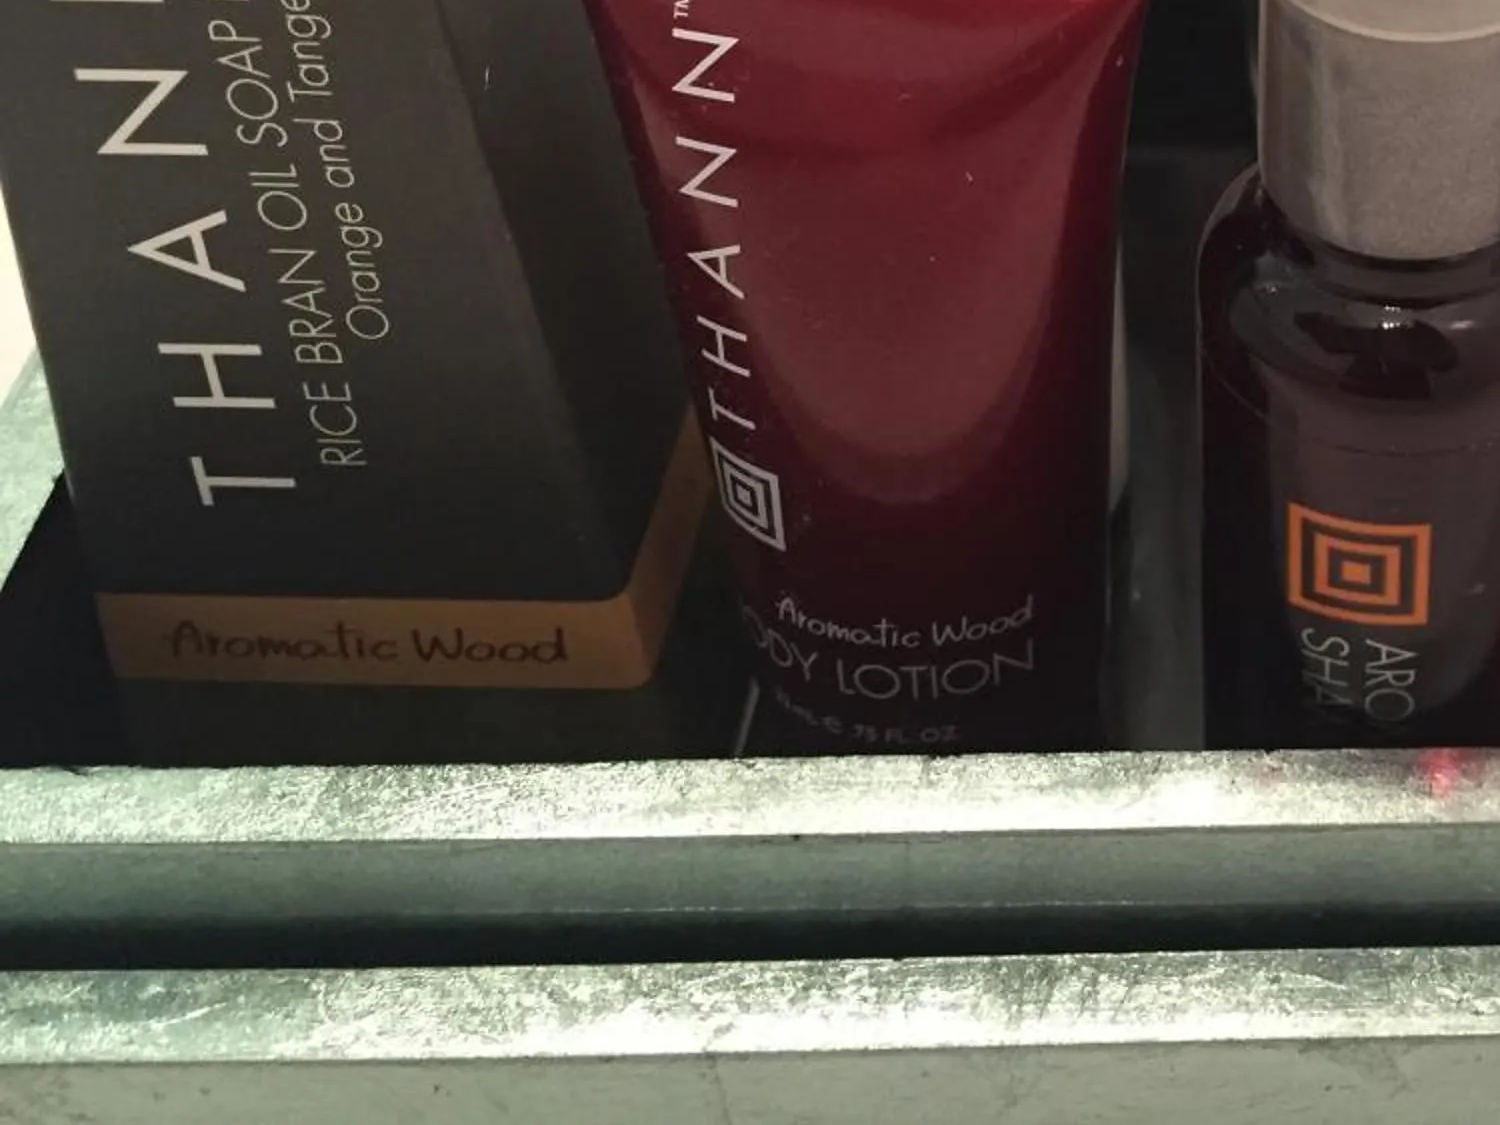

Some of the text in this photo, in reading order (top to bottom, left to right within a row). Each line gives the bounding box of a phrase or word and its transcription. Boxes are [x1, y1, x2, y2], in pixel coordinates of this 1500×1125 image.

[208, 19, 288, 147] SOAP
[293, 118, 354, 188] and
[248, 163, 308, 231] OIL
[672, 28, 755, 429] THANN
[268, 248, 344, 365] BRAN
[334, 201, 389, 341] Orange
[304, 381, 367, 466] RICE
[163, 622, 568, 664] Aromatic Wood
[776, 593, 1034, 648] Aromatic Wood
[837, 637, 1035, 700] LOTION
